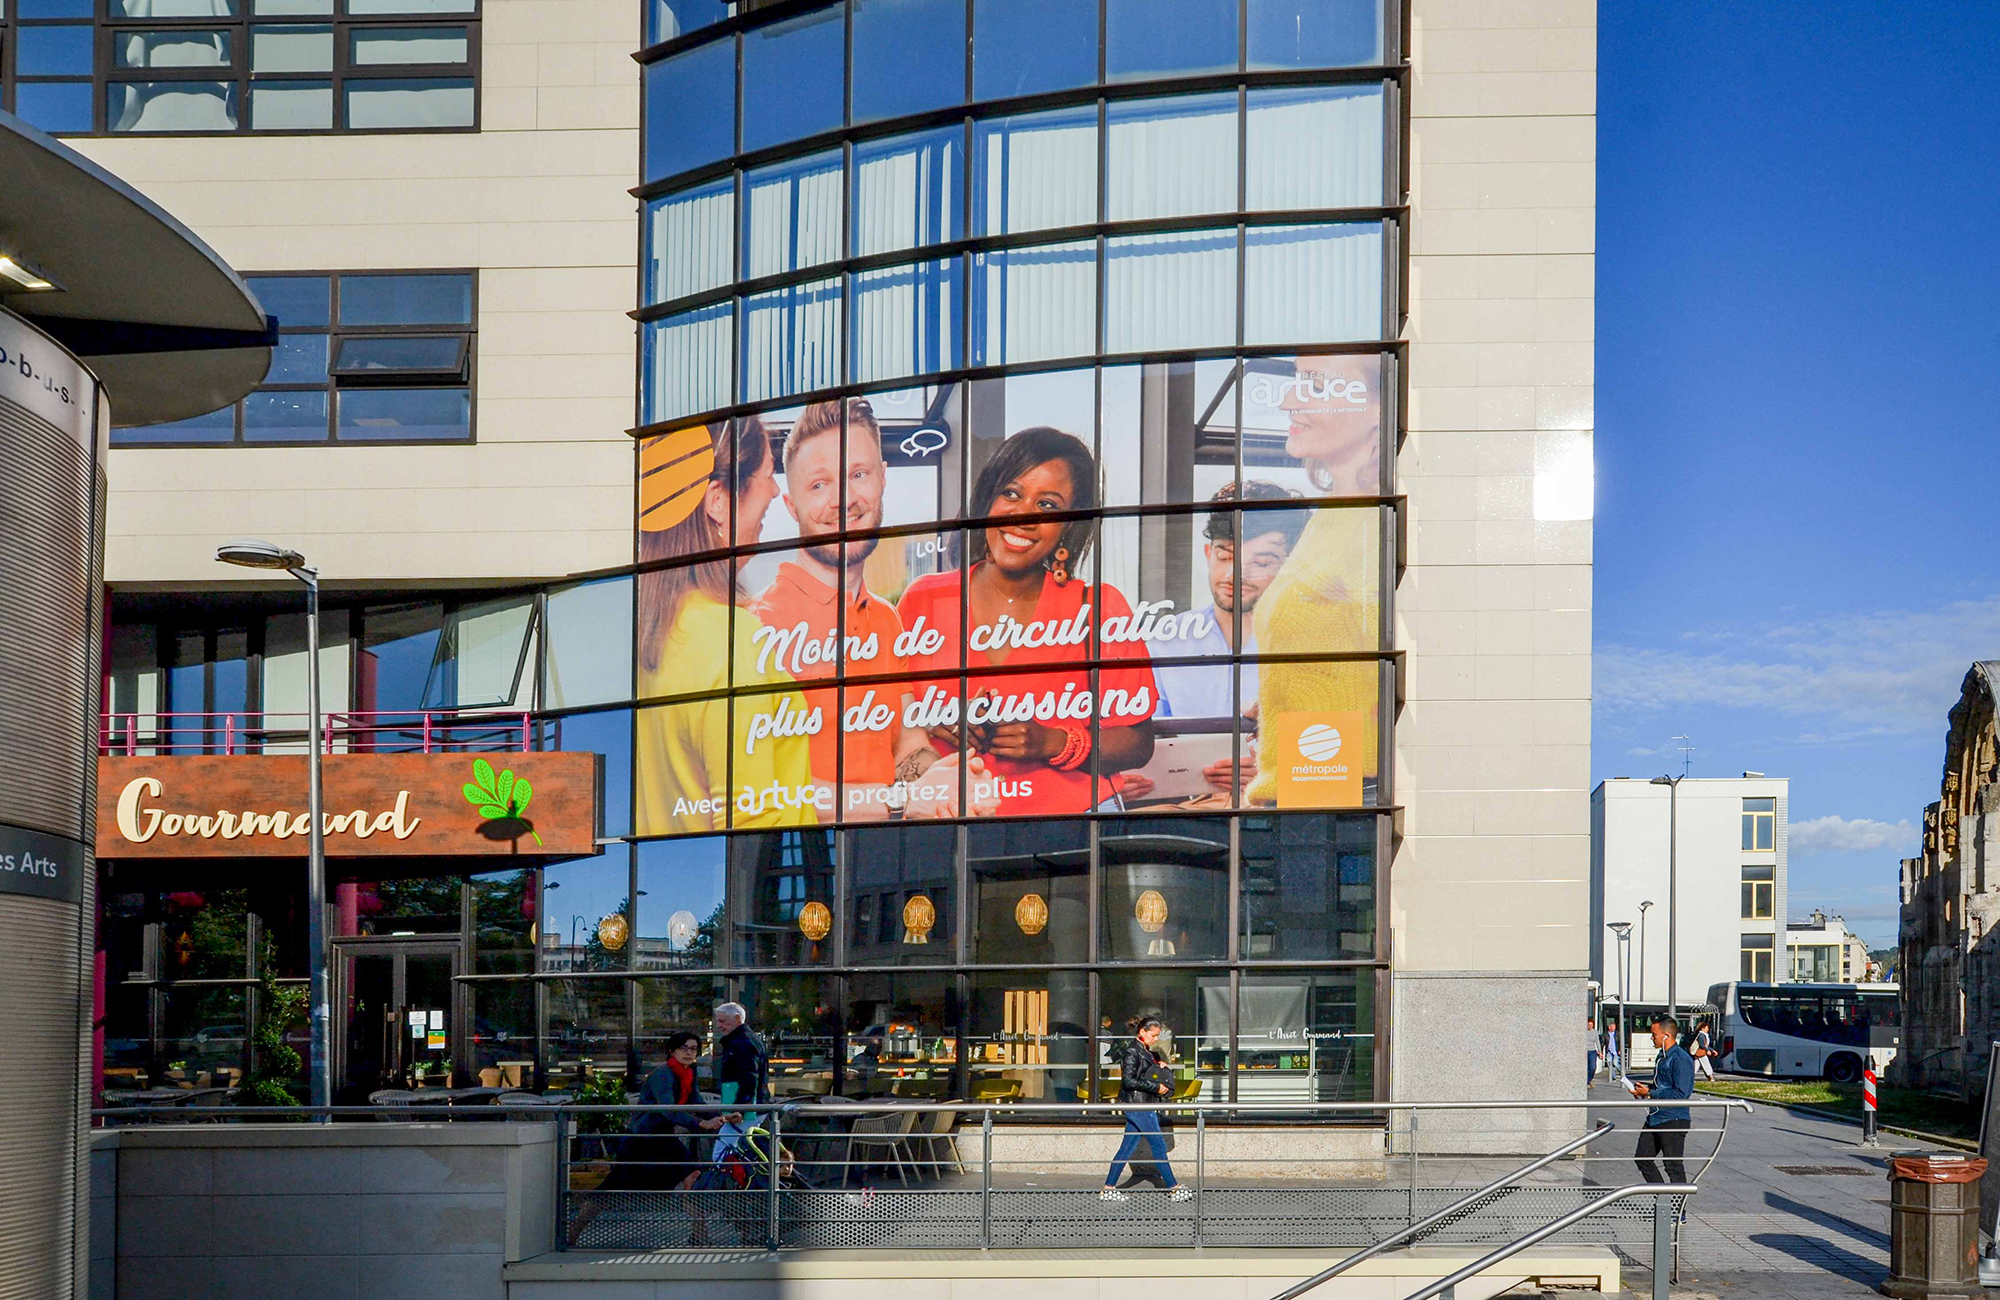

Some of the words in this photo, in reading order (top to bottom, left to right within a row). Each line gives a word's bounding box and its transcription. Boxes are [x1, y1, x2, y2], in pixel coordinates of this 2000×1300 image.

[1250, 372, 1367, 408] astuce
[1302, 370, 1346, 380] RÉSEAU
[916, 536, 947, 558] LOL
[752, 620, 879, 673] Moins
[893, 616, 945, 658] de
[746, 696, 823, 754] plus
[842, 689, 895, 732] de
[903, 682, 1152, 728] discussions
[1291, 763, 1348, 775] métropole
[116, 776, 422, 843] Gourmand
[672, 797, 723, 817] Avec
[736, 780, 833, 815] astuce
[848, 780, 949, 810] profitez
[974, 776, 1033, 804] plus
[20, 851, 57, 878] Arts
[1302, 1027, 1342, 1040] Gourmand
